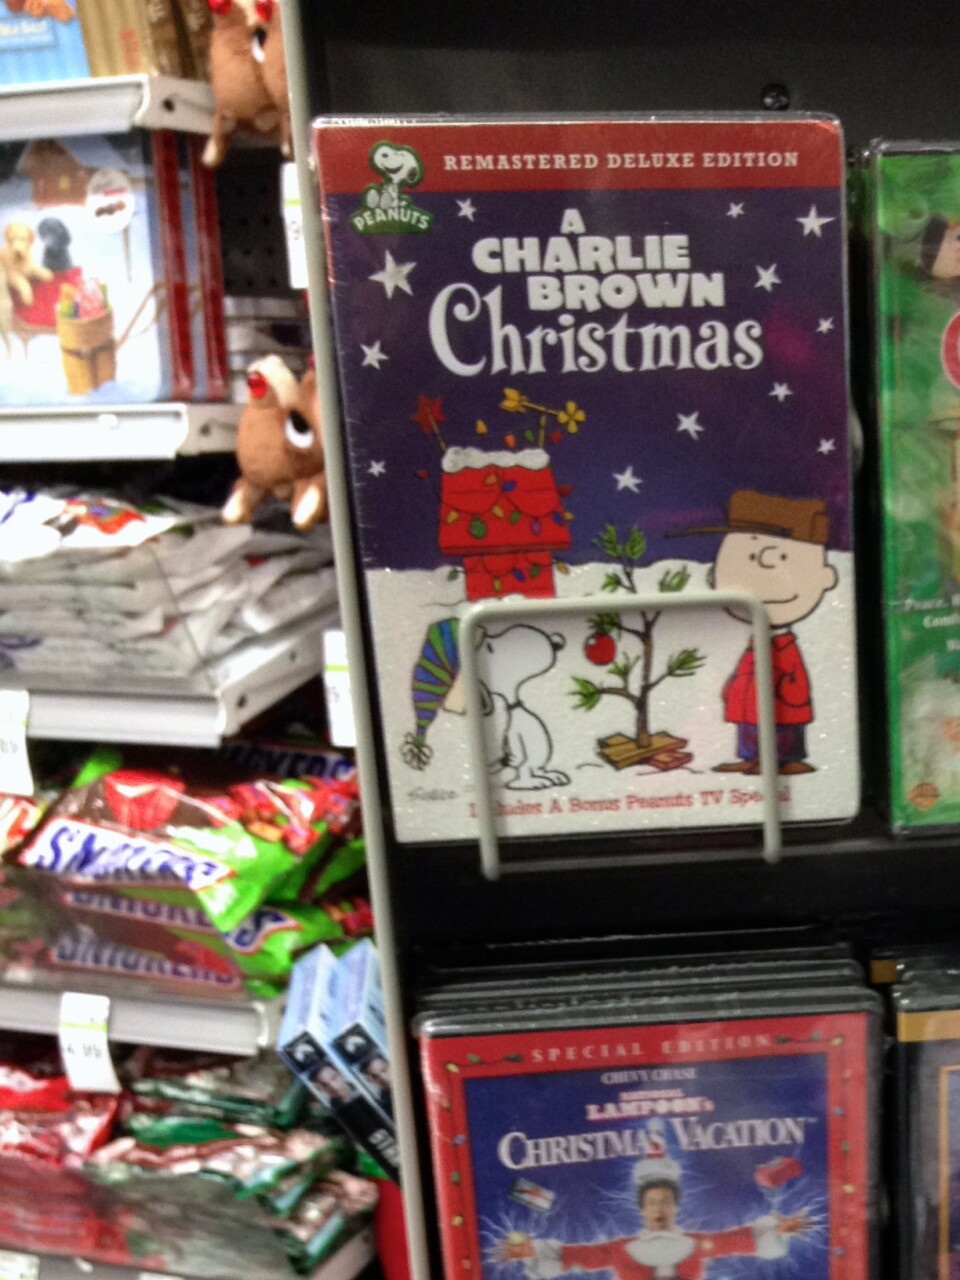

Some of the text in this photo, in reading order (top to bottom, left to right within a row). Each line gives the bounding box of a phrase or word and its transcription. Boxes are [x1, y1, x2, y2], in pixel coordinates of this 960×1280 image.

[443, 151, 799, 171] REMASTERED DELUXE EDITION
[352, 206, 430, 230] PEANUTS
[560, 208, 586, 234] A
[471, 234, 691, 274] CHARLIE
[526, 272, 725, 312] BROWN
[428, 282, 764, 376] Christmas
[549, 798, 563, 814] A
[569, 797, 620, 812] Bonus
[626, 794, 693, 810] Peanuts
[701, 789, 724, 806] TV
[532, 1034, 772, 1062] SPECIAL EDITION
[499, 1116, 805, 1170] CHRISTMAS VACATION
